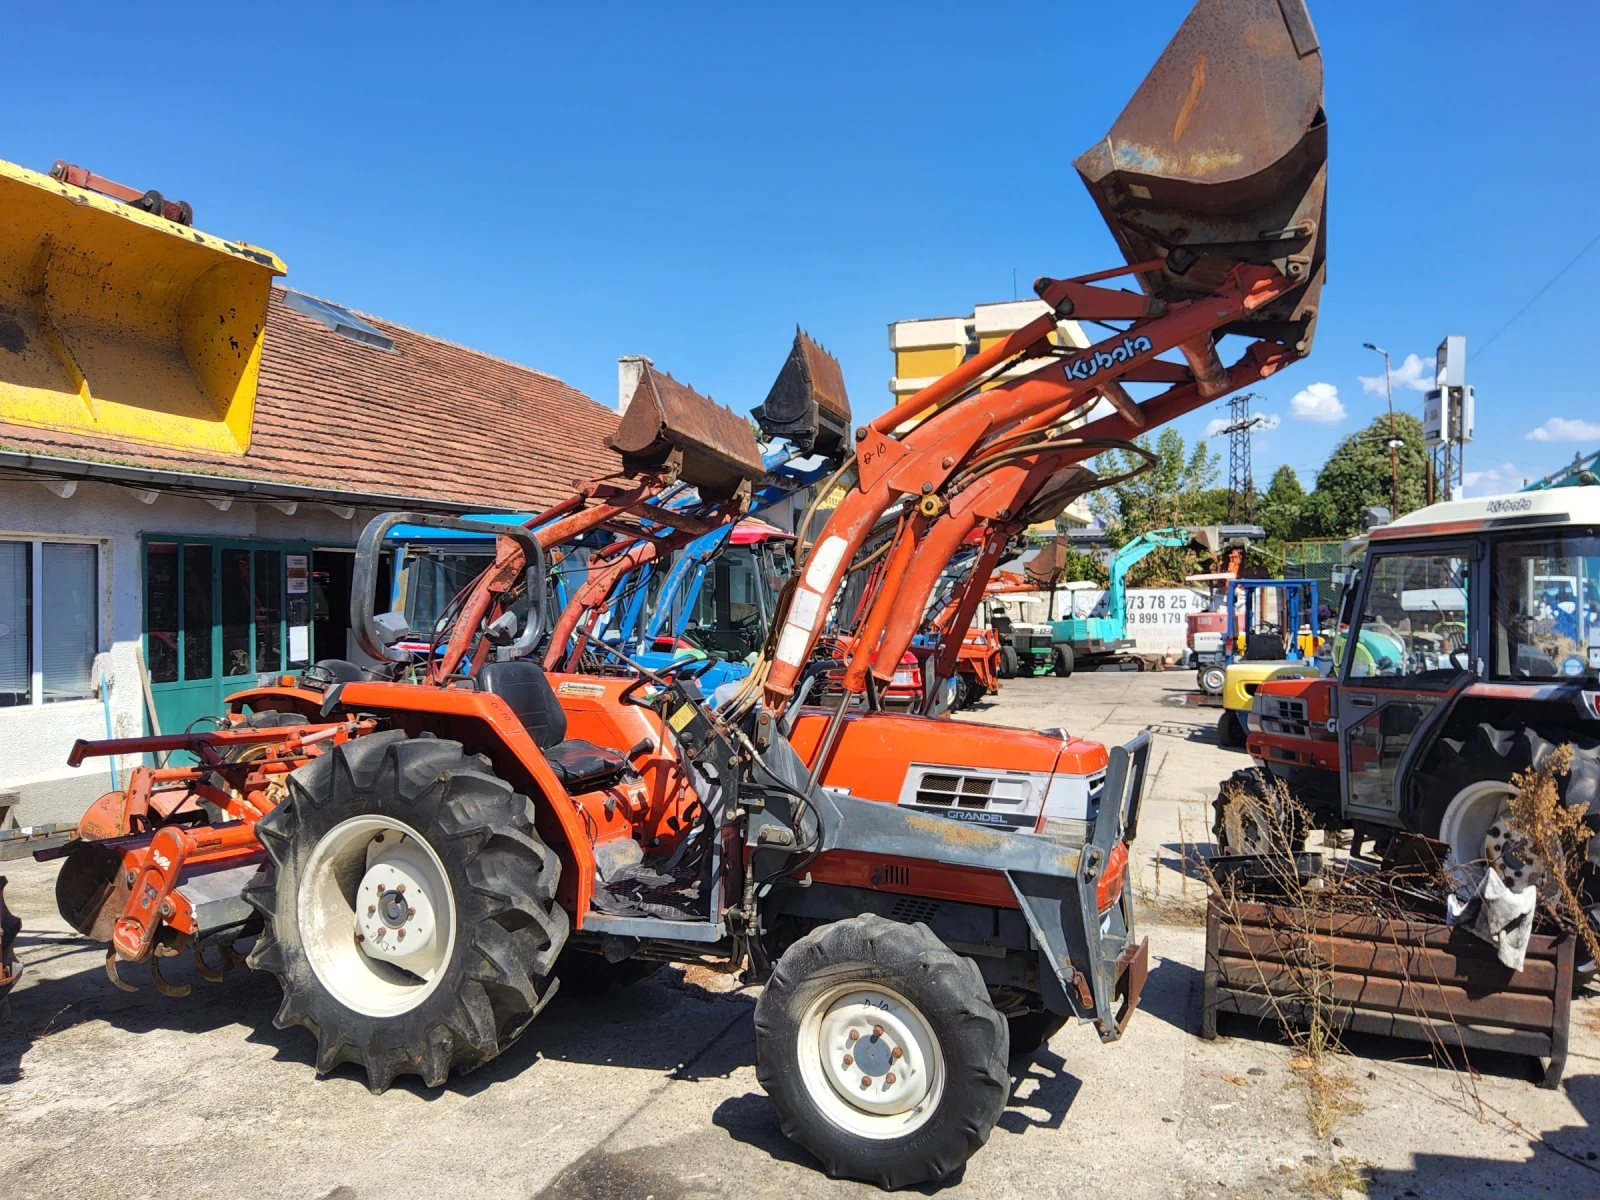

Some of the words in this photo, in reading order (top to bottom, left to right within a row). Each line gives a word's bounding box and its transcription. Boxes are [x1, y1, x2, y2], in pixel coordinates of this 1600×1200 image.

[1063, 335, 1153, 381] Kubota
[1486, 498, 1532, 512] Kubota
[1149, 595, 1166, 609] 78
[1170, 595, 1187, 609] 25
[1139, 612, 1158, 624] 899
[1162, 612, 1181, 624] 179
[947, 810, 1008, 824] GRANDEL
